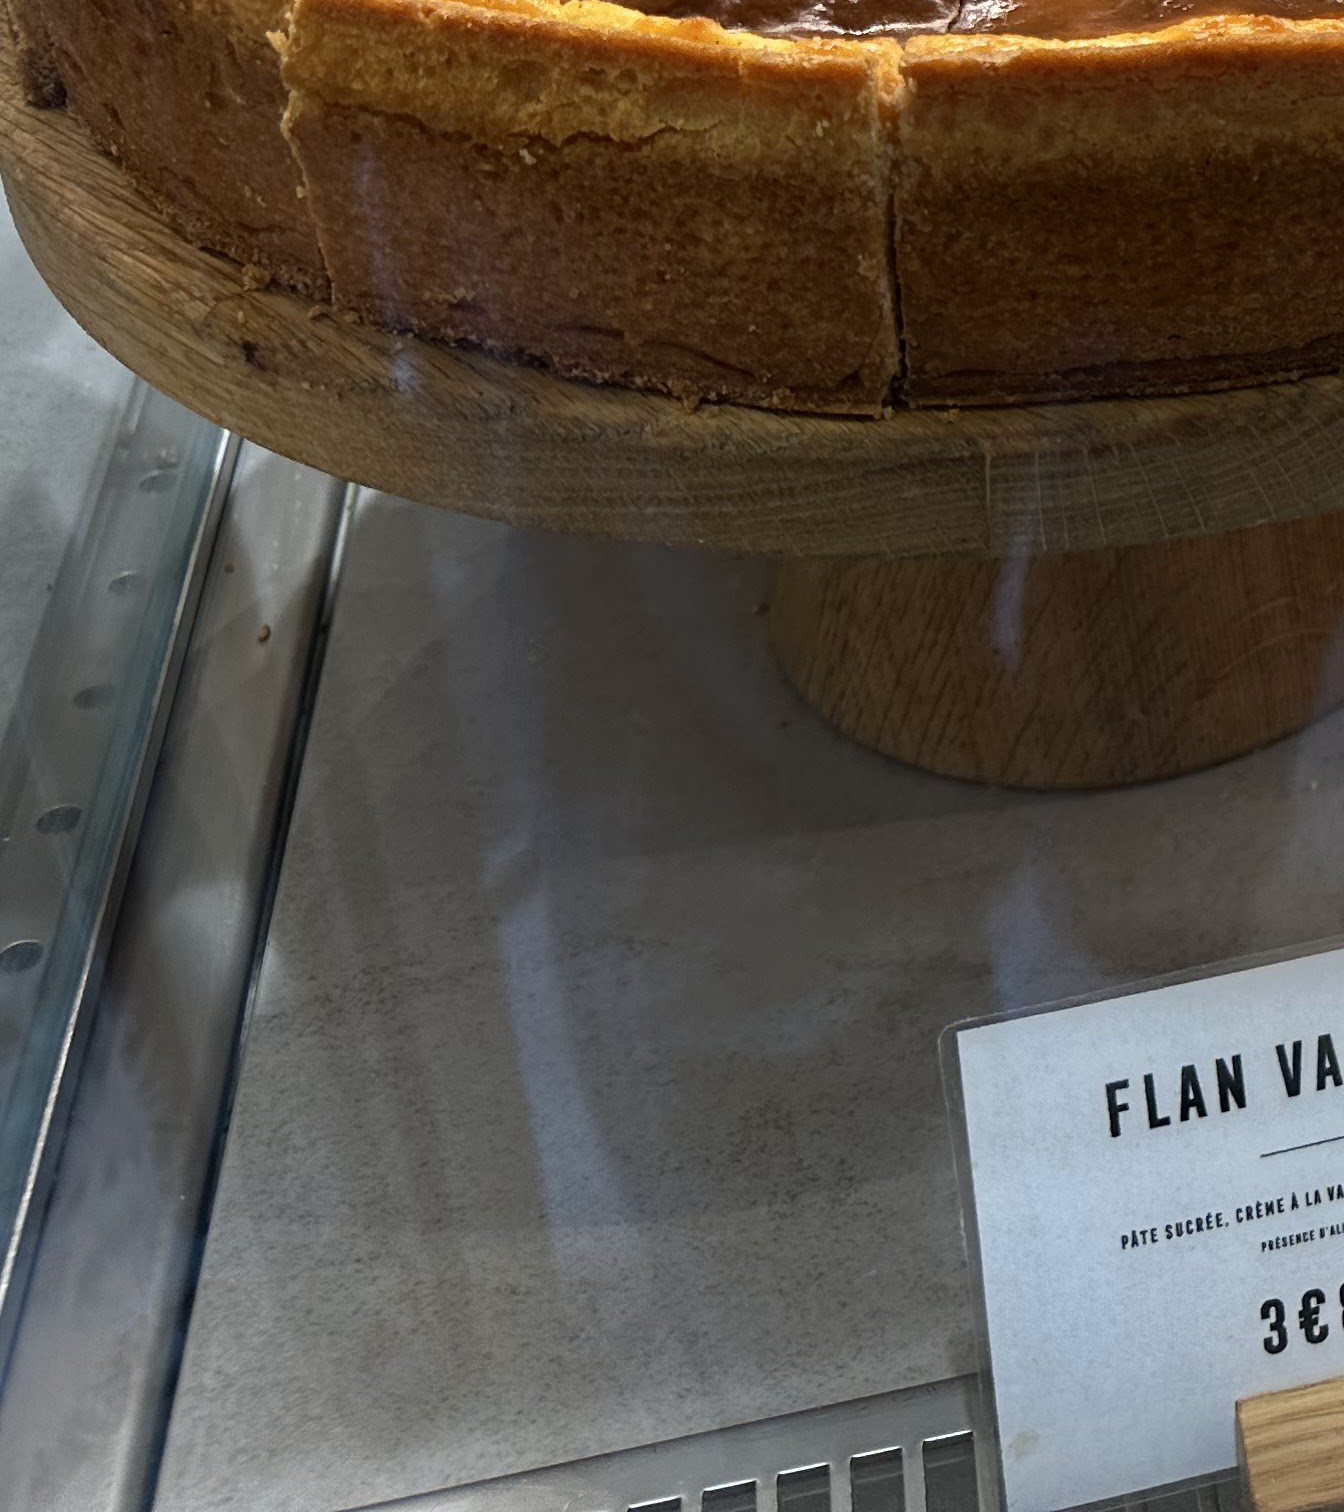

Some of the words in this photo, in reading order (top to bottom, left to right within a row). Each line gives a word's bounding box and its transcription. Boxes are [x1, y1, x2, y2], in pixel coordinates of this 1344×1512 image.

[1104, 1053, 1248, 1139] FLAN
[1120, 1226, 1159, 1251] PÂTE
[1289, 1191, 1301, 1212] À
[1304, 1188, 1323, 1208] LA
